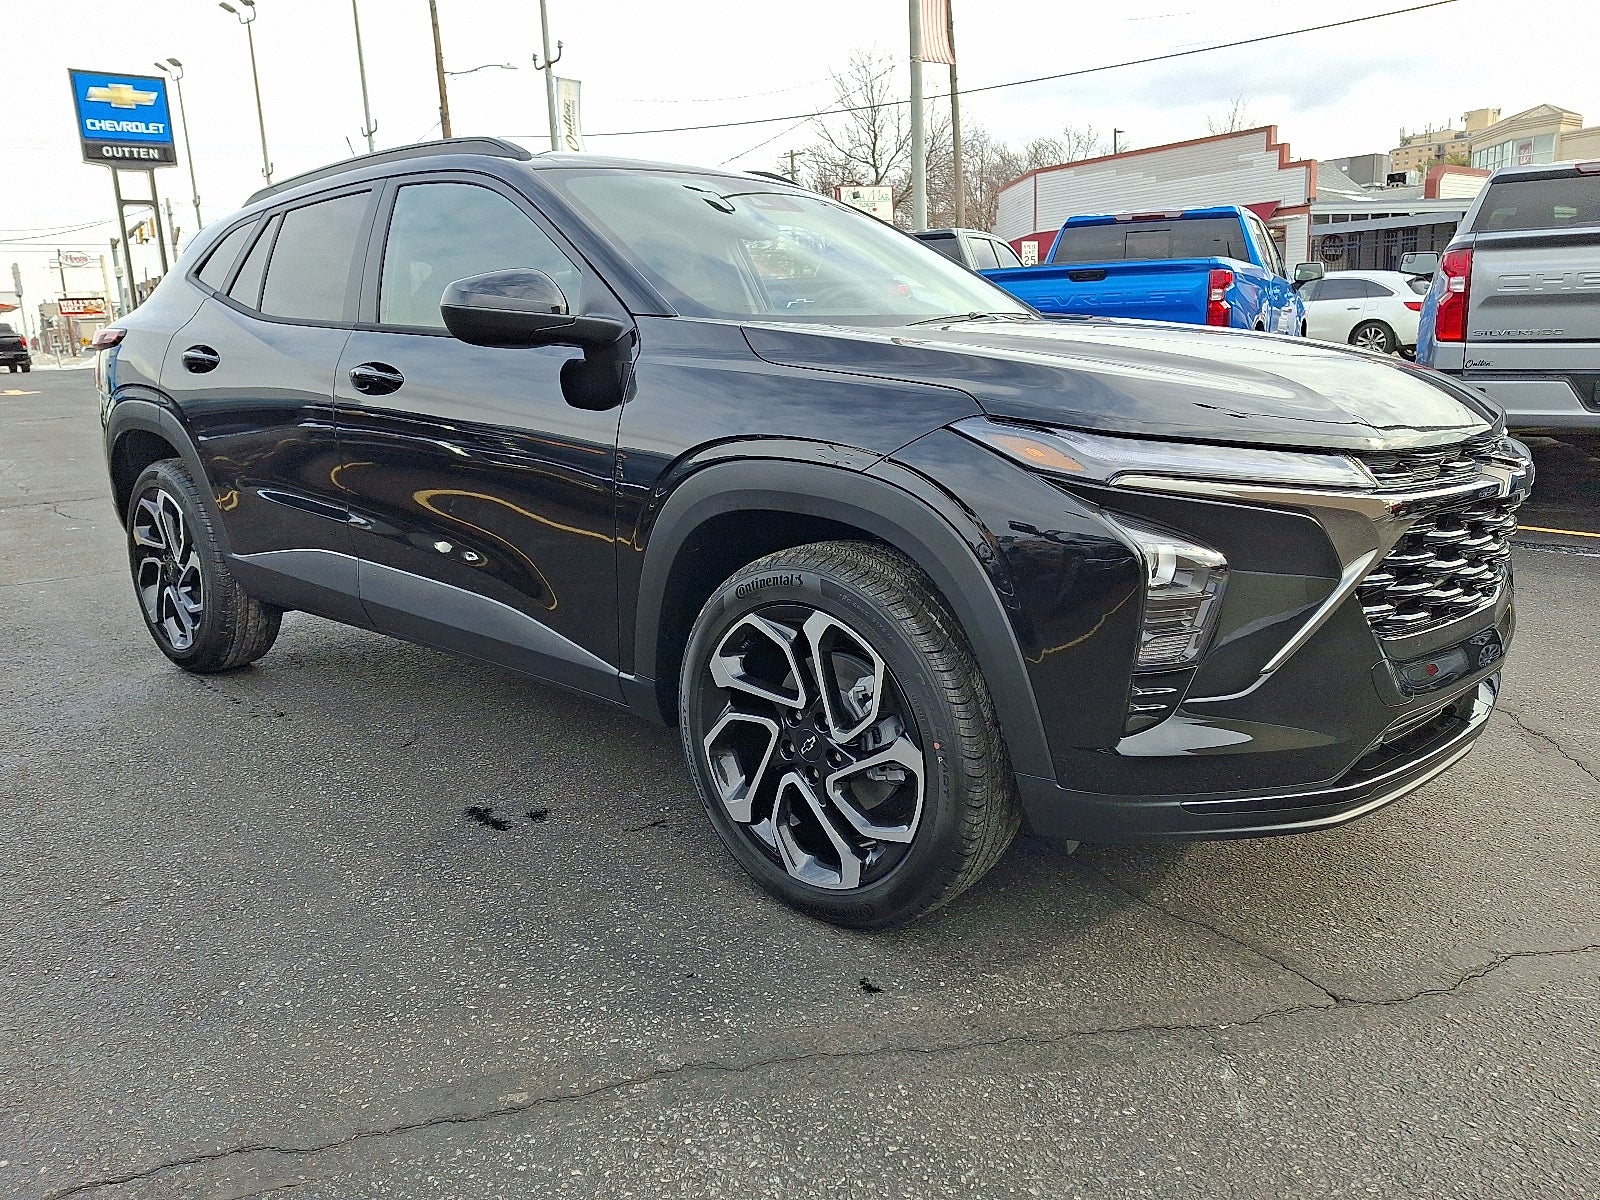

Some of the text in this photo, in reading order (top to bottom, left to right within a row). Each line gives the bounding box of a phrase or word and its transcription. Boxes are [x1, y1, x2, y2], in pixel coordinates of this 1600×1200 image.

[86, 118, 165, 134] CHEVROLET
[563, 99, 580, 152] Outten
[102, 146, 159, 159] OUTTEN
[1023, 255, 1037, 266] 25
[1473, 328, 1564, 337] SILVERADO
[1464, 359, 1493, 369] Outten
[735, 574, 794, 600] Continental
